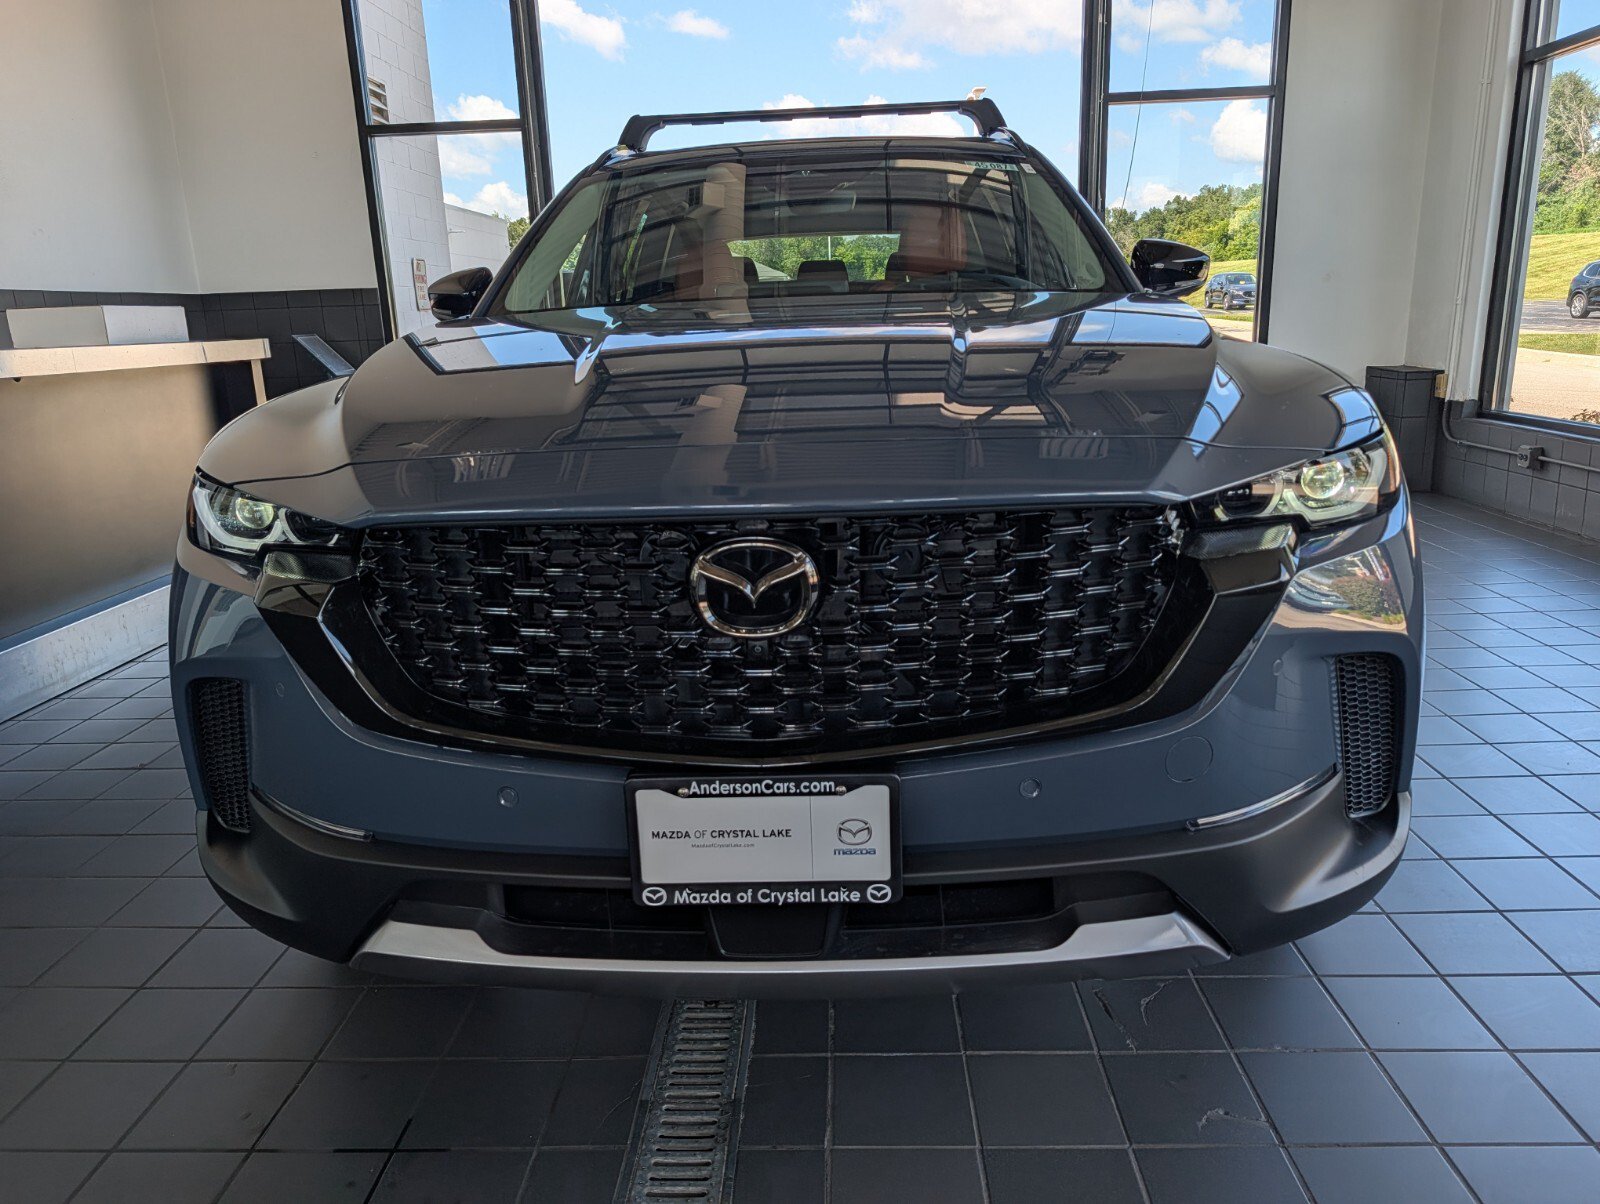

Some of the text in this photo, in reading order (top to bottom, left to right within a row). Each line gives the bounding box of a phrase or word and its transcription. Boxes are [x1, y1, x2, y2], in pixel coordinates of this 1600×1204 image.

[689, 780, 836, 795] AndersonCars.com
[651, 828, 792, 840] MAZDA OF CRYSTAL LAKE
[674, 886, 861, 906] Mazda of Crystal Lake
